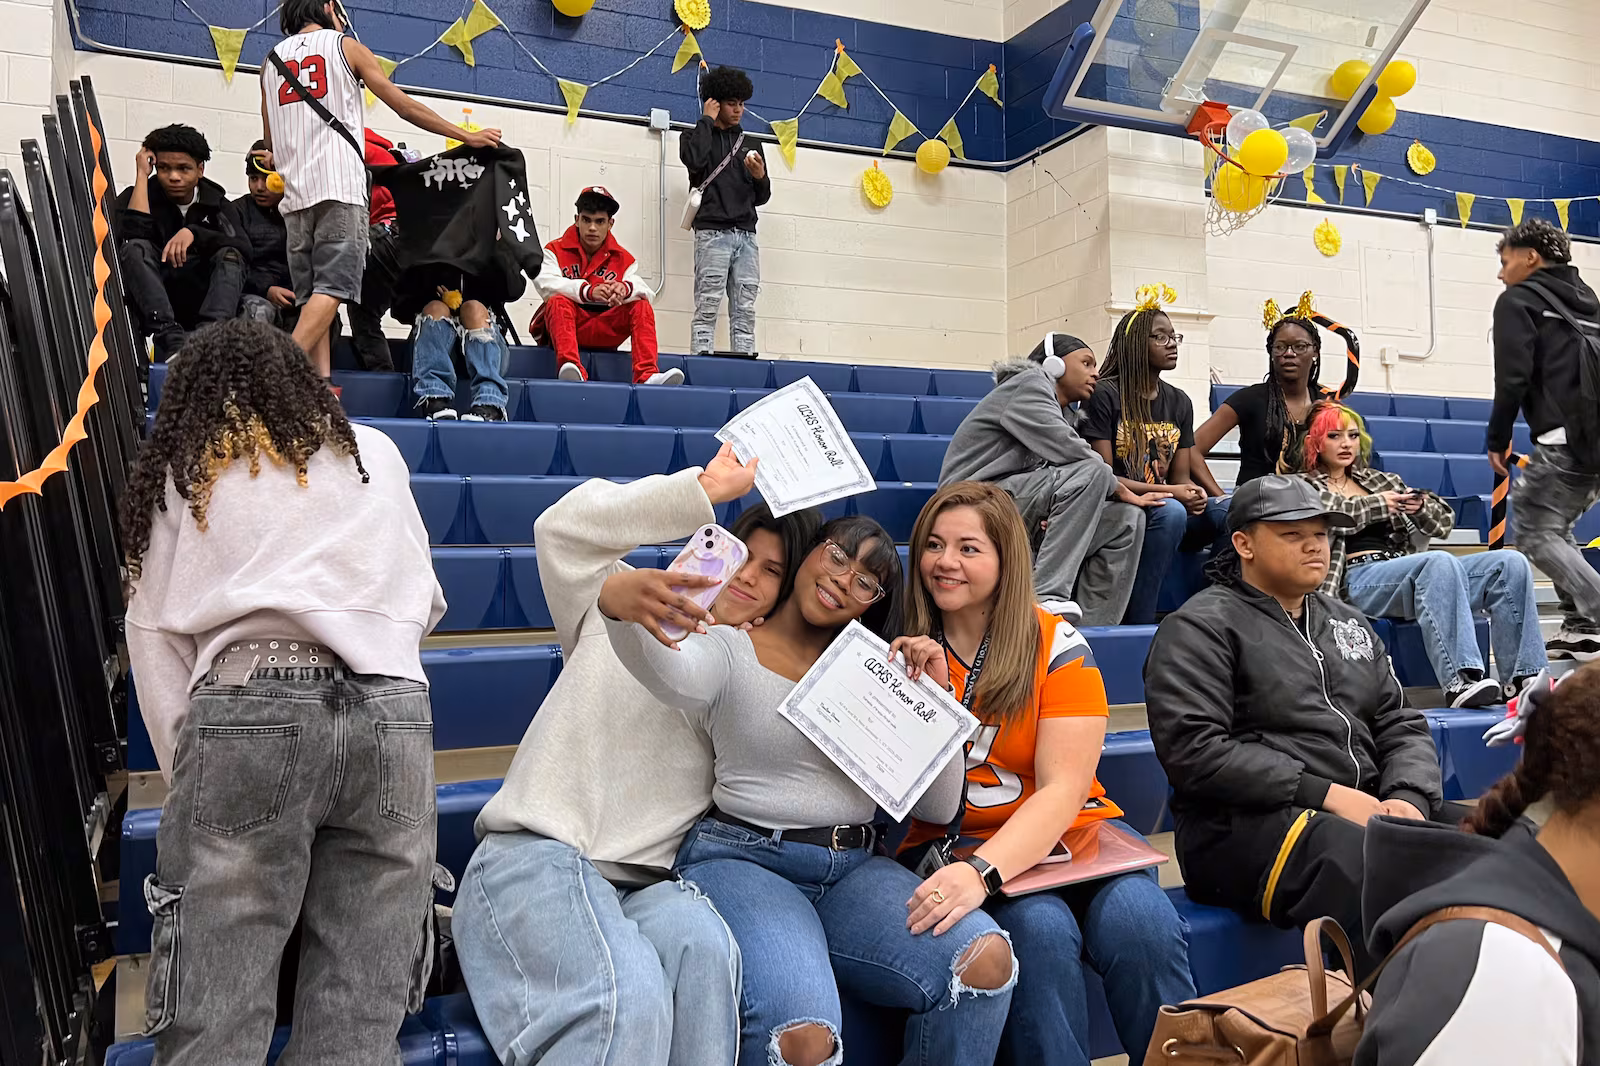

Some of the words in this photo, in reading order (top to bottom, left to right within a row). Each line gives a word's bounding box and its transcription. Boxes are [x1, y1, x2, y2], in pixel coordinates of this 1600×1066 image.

[278, 54, 328, 106] 23
[797, 405, 819, 425] ACHS
[811, 426, 828, 449] Honor
[824, 451, 844, 467] Roll
[864, 658, 892, 684] ACHS
[888, 680, 914, 705] Honor
[914, 701, 935, 723] Roll
